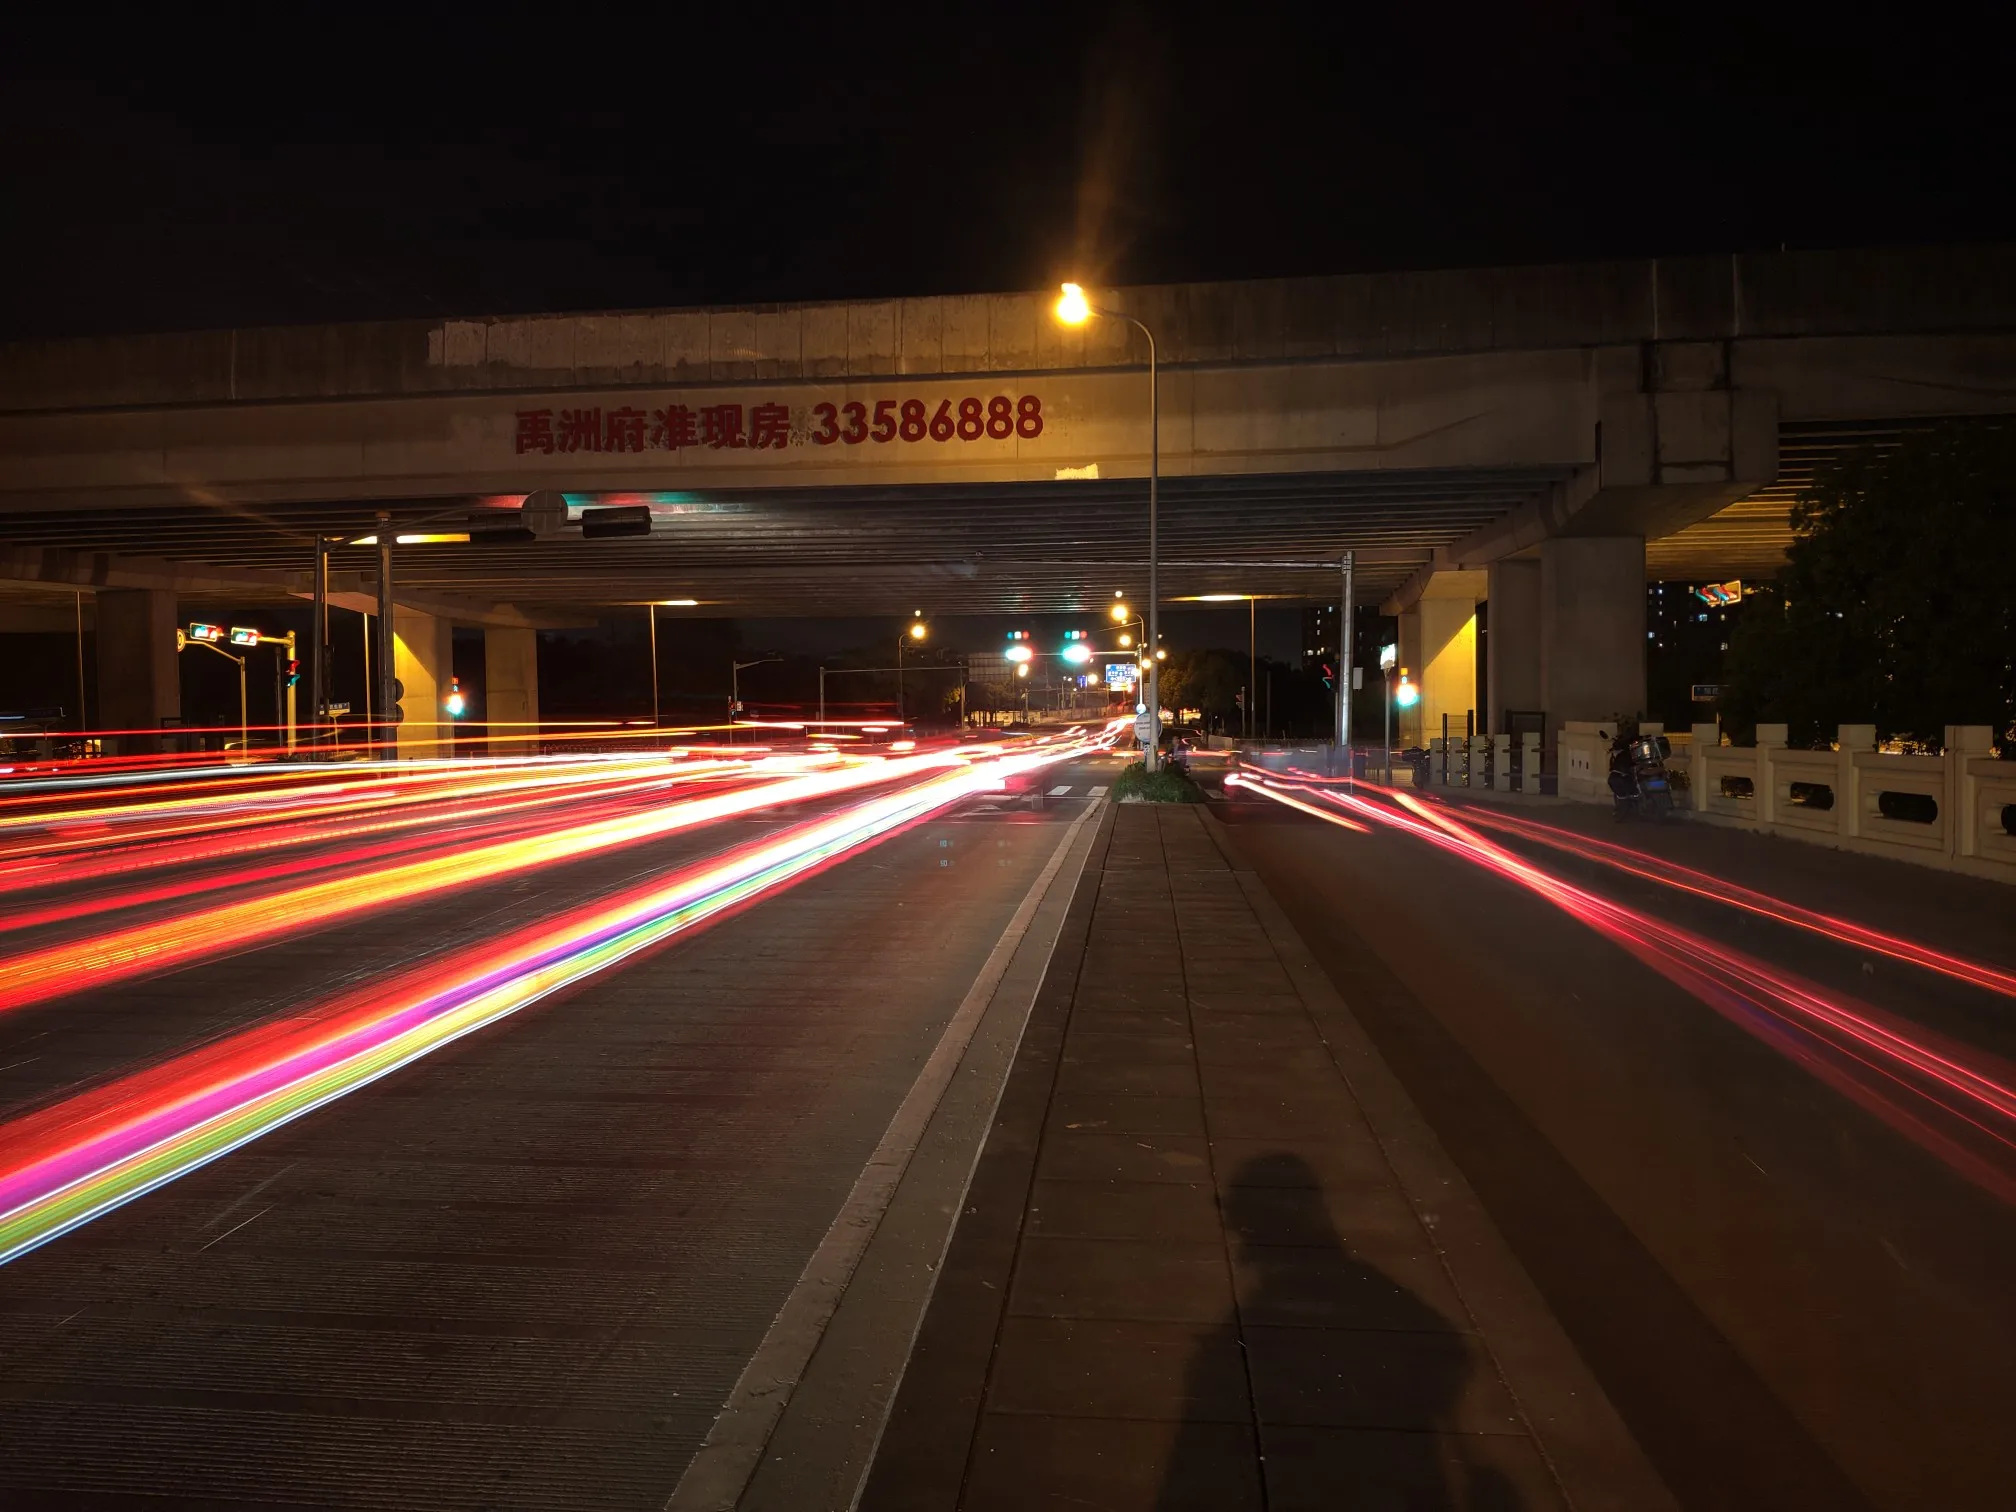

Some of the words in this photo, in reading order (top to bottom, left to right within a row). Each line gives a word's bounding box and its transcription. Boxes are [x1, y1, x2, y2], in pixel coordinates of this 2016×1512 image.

[515, 402, 790, 454] 禹洲府准现房
[811, 395, 1044, 445] 33586888
